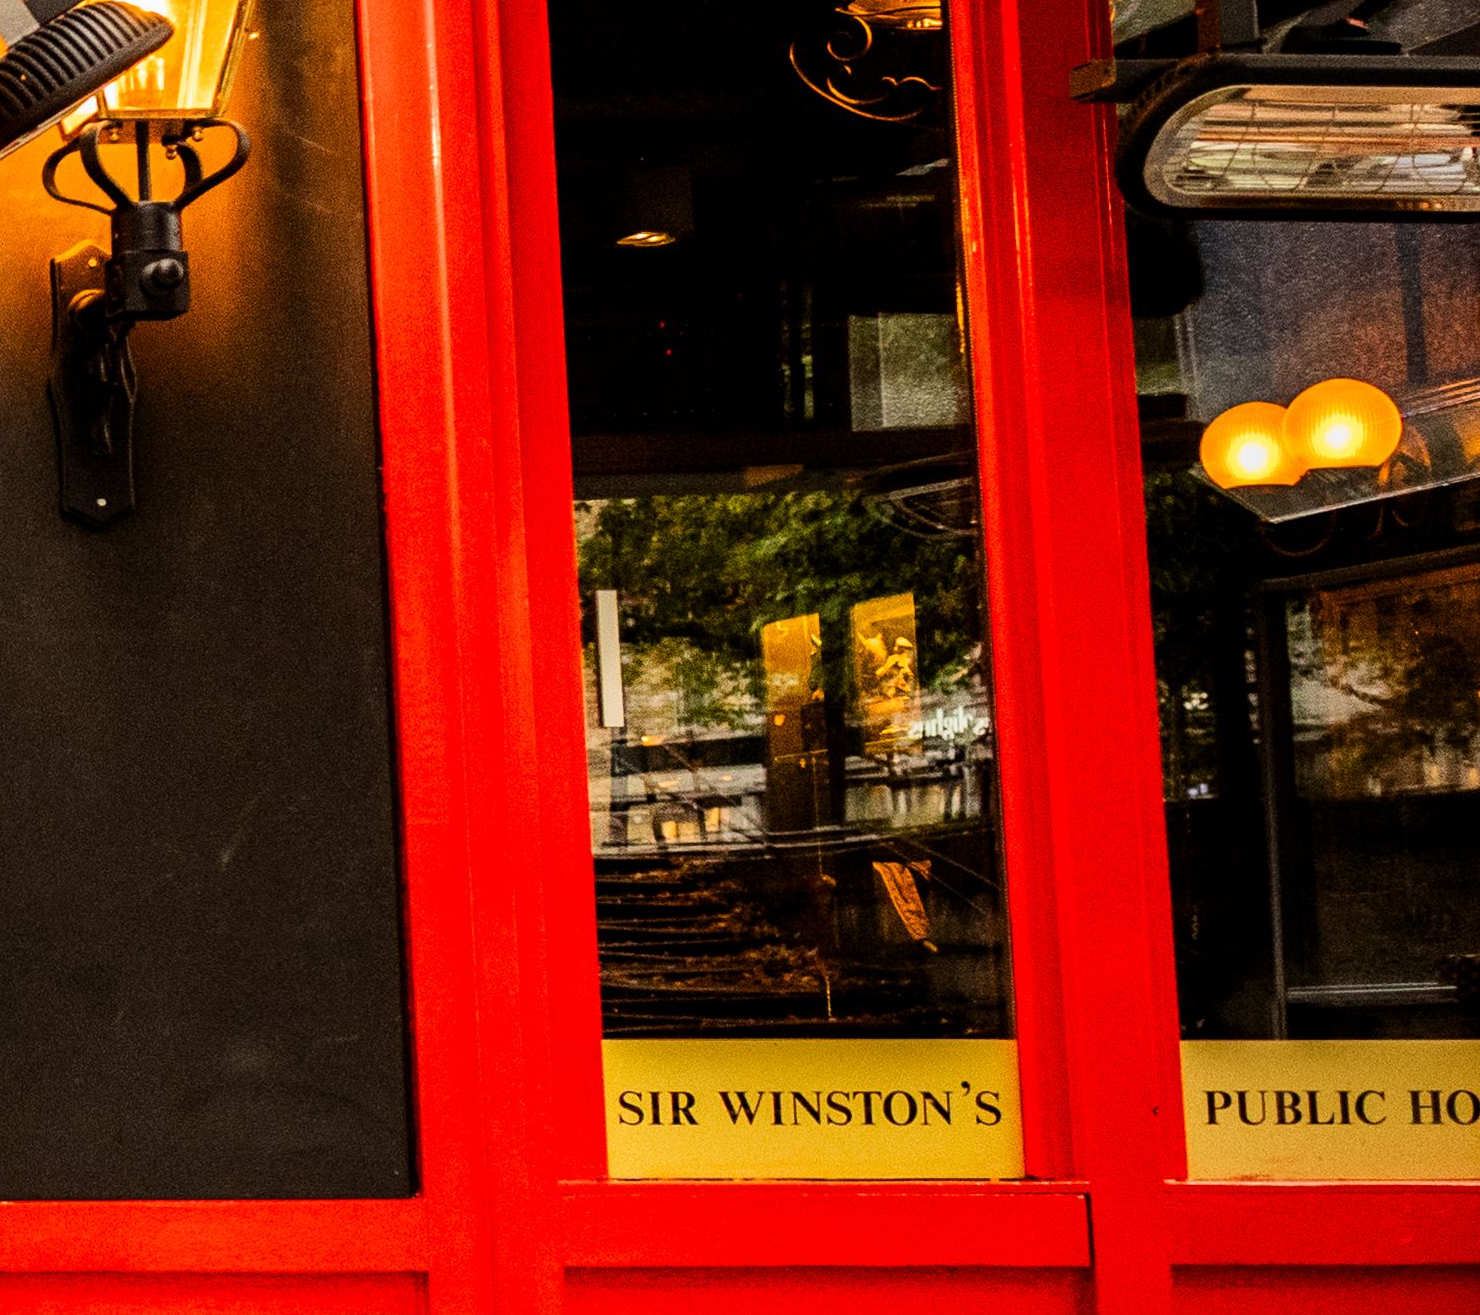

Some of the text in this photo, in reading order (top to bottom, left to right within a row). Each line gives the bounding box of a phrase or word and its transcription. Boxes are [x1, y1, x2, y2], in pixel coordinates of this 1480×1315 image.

[618, 1081, 1002, 1126] SIR WINSTON'S
[1204, 1089, 1387, 1126] PUBLIC
